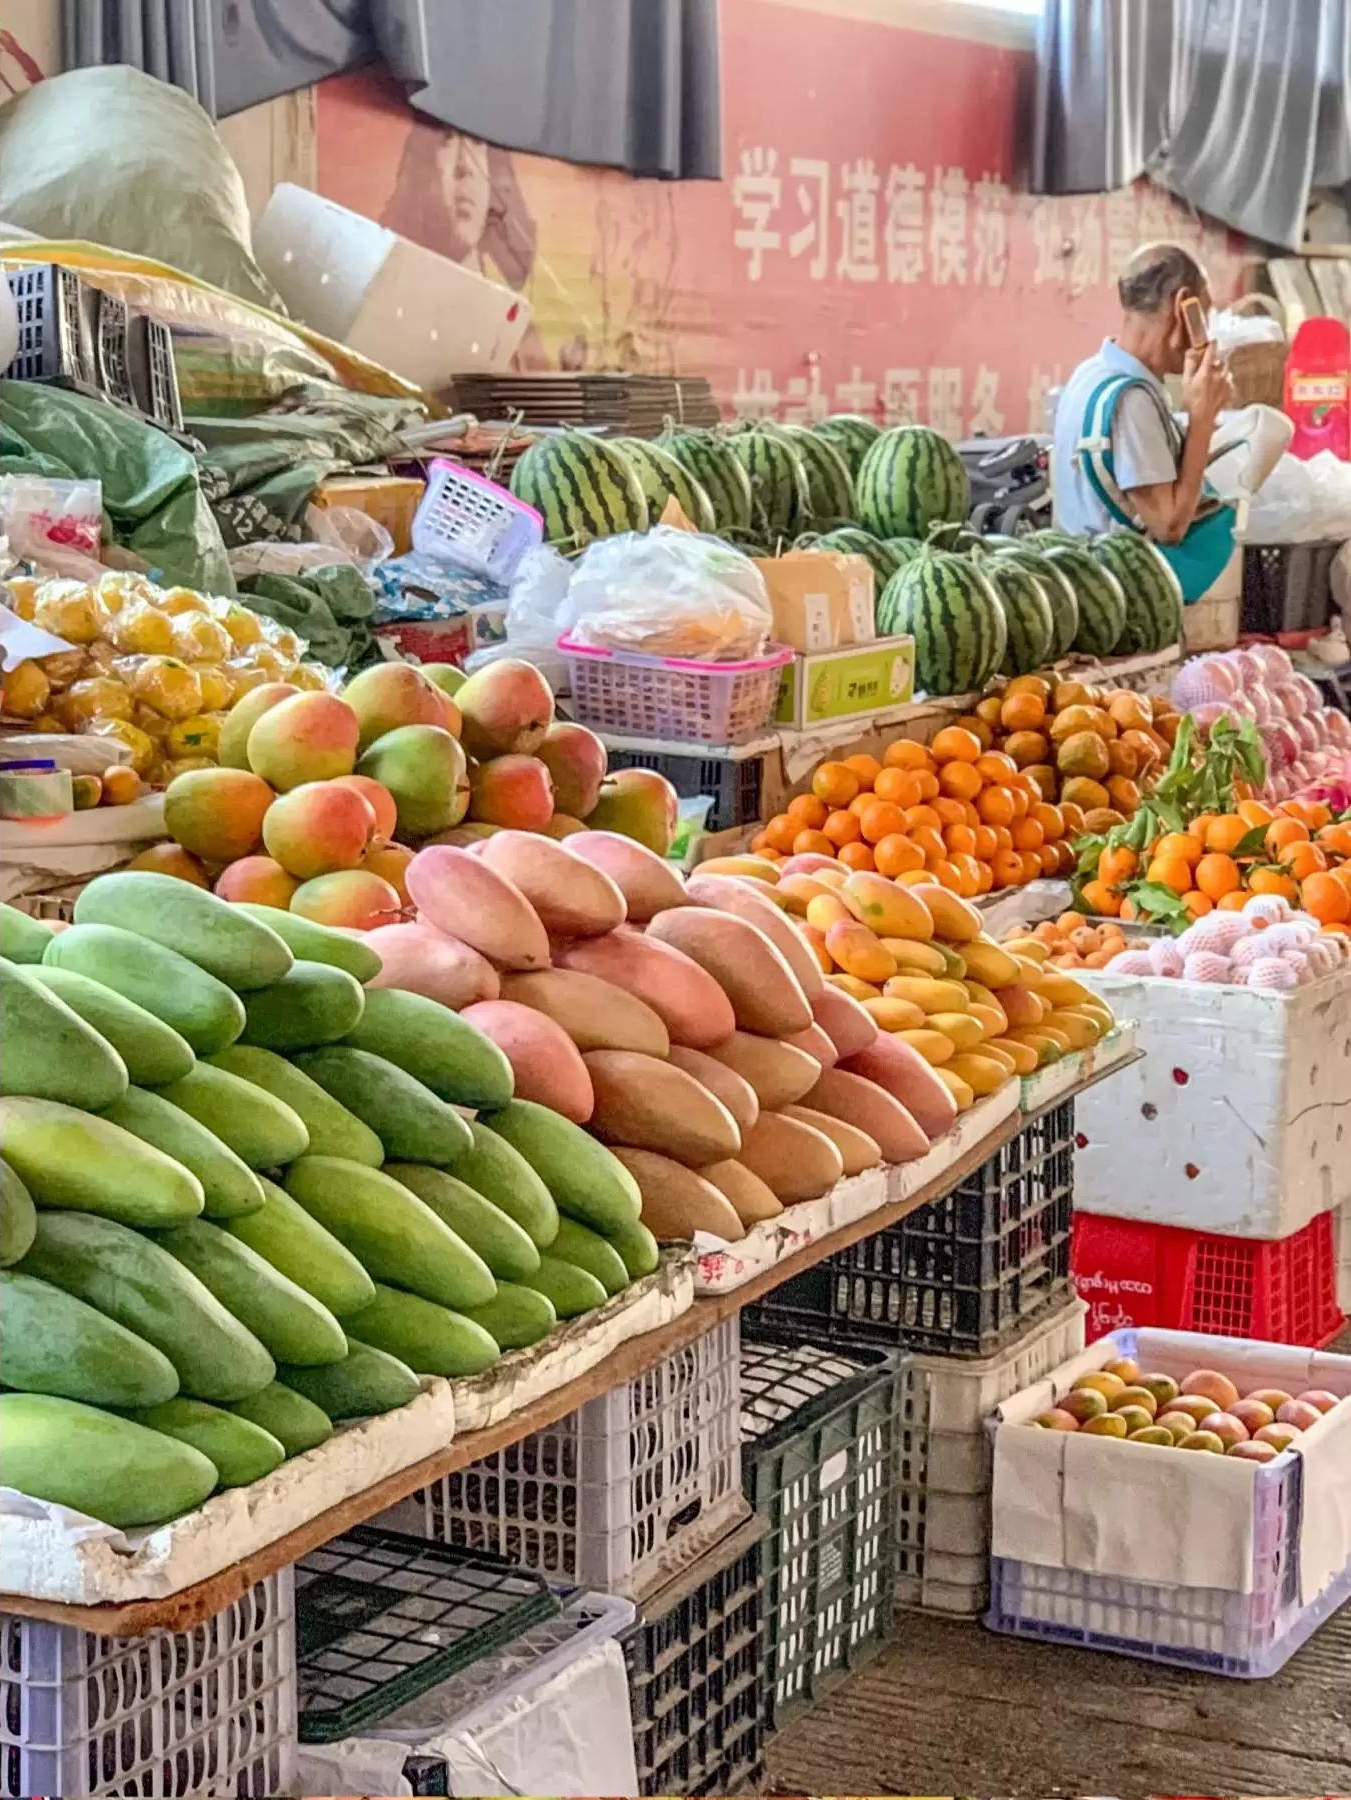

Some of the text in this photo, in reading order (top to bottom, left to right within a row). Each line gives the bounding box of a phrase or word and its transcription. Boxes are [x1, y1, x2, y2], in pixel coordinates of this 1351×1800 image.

[732, 146, 1011, 286] 学习道德模范
